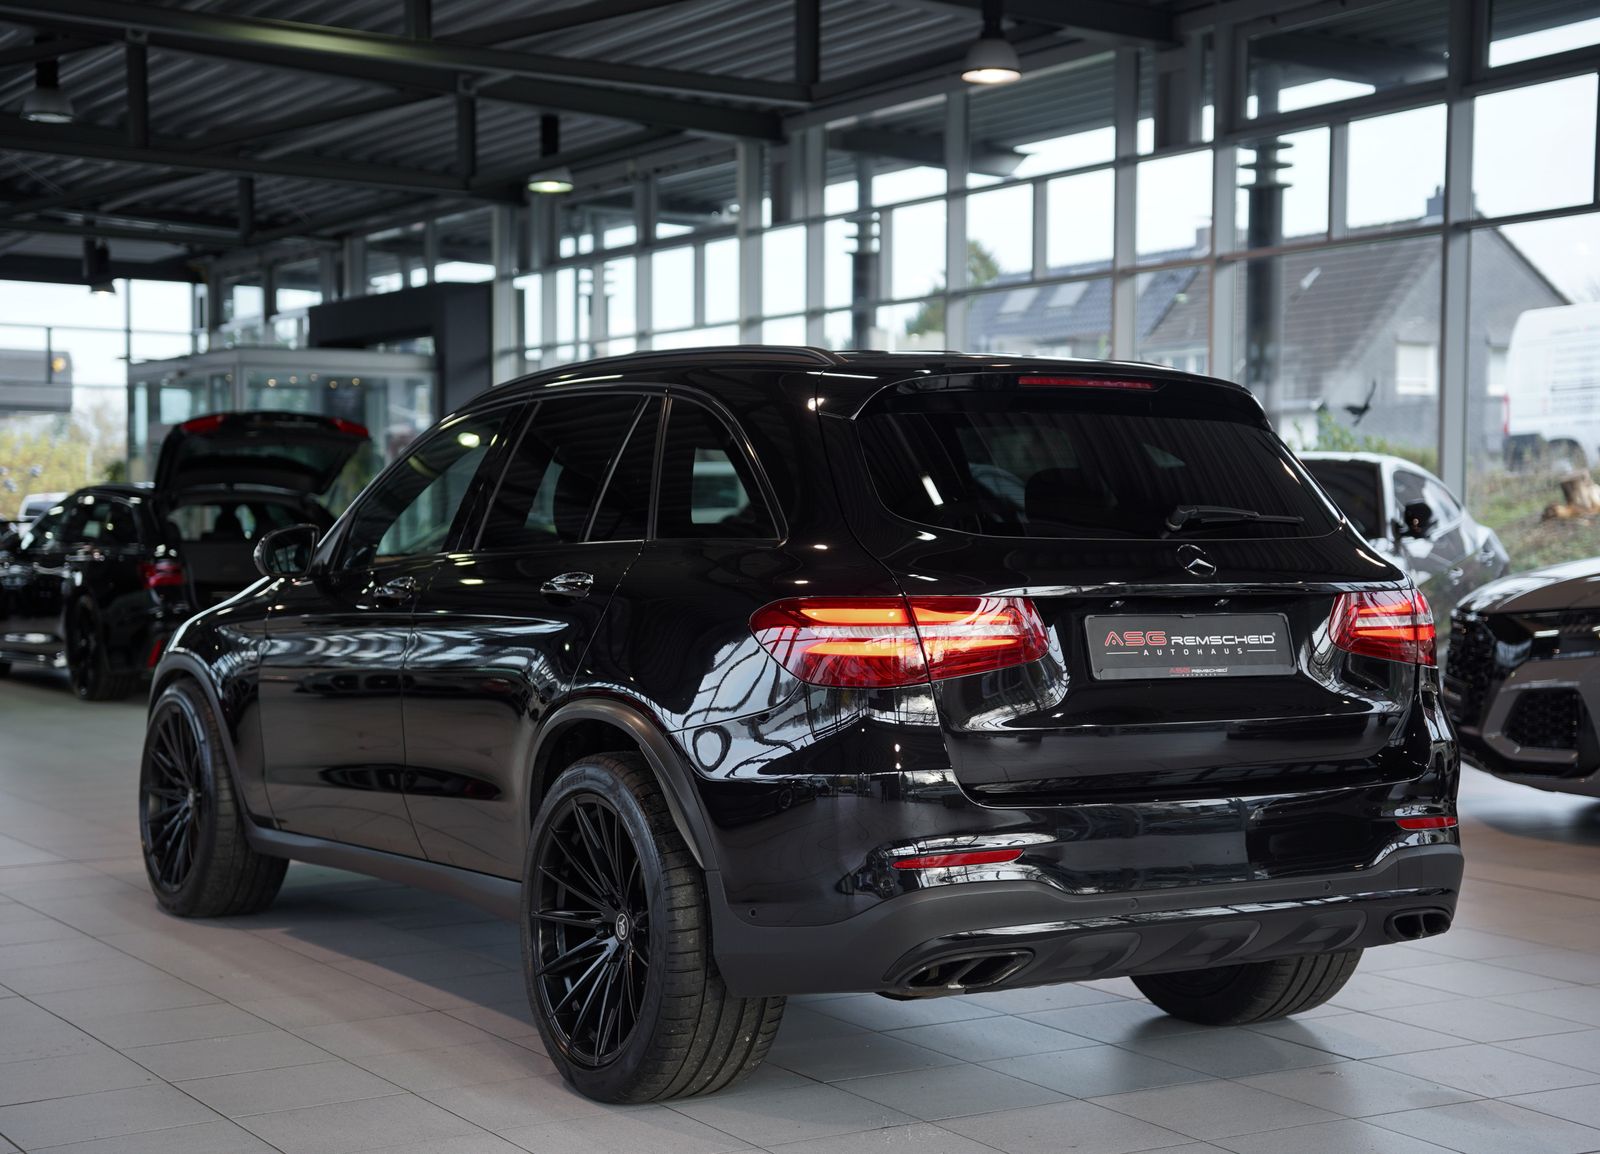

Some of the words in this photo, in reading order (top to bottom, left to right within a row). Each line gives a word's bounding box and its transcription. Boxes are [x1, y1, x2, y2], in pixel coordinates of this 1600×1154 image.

[1104, 631, 1167, 647] ASG
[1170, 634, 1275, 645] REMSCHEID
[1143, 648, 1243, 656] AUTOHAUS
